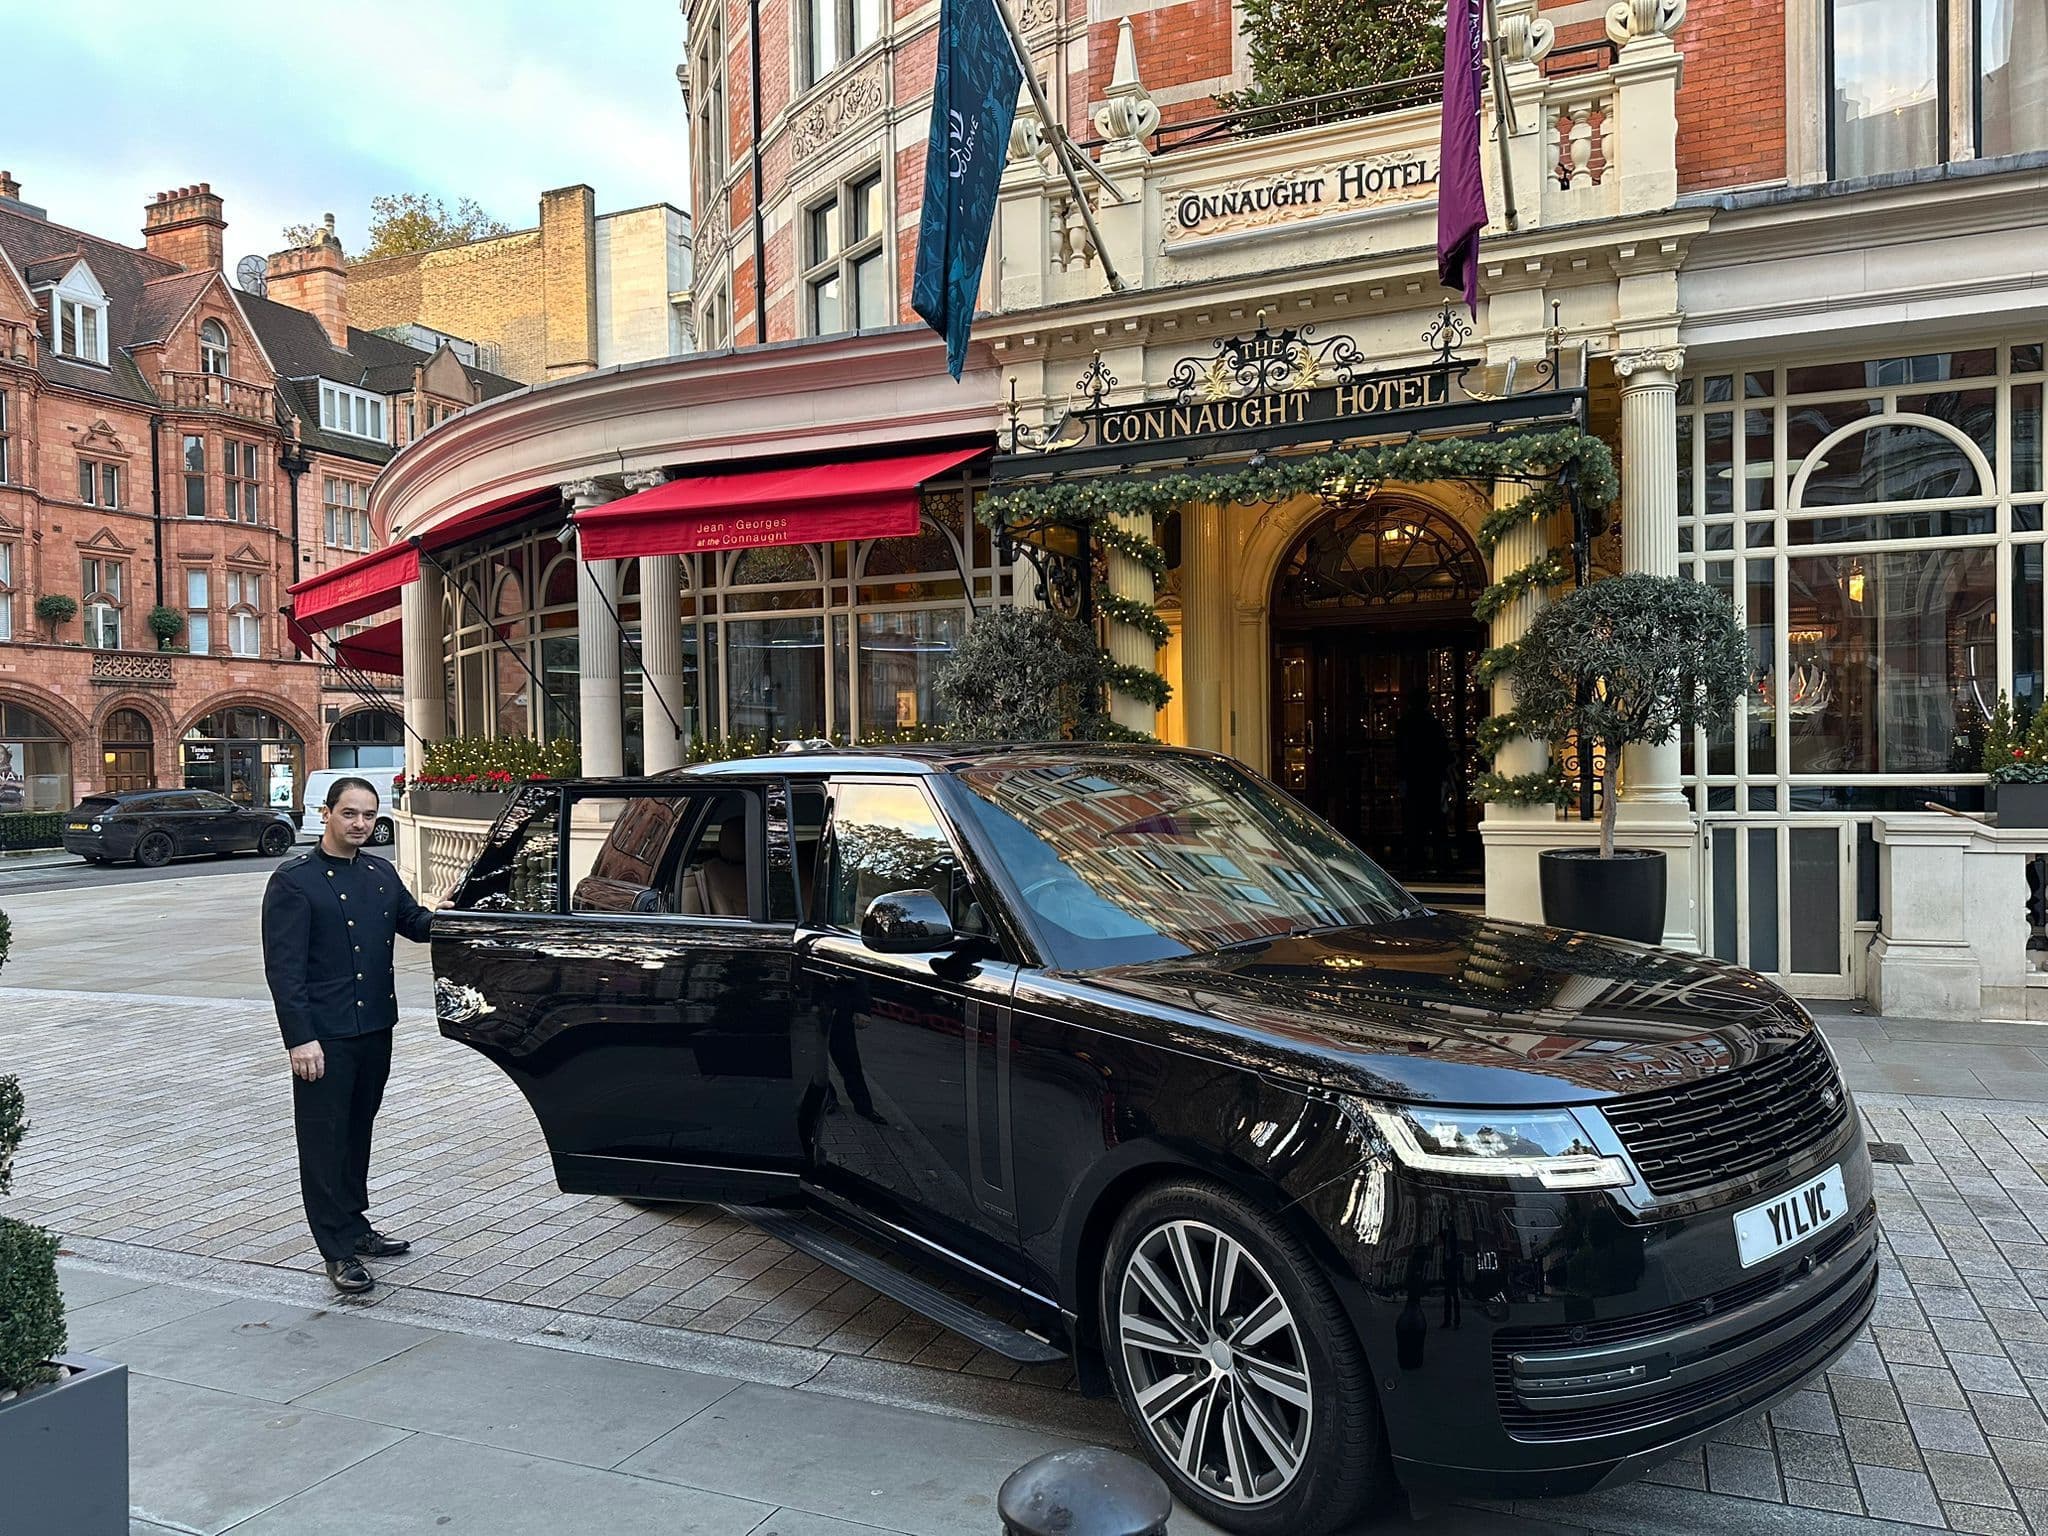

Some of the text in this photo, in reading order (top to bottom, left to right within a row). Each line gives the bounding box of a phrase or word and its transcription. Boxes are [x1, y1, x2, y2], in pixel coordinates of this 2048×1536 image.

[1178, 160, 1438, 228] CONNAUGHT HOTEL
[1240, 337, 1284, 360] THE
[1102, 375, 1445, 444] CONNAUGHT HOTEL
[696, 523, 724, 534] Jean
[735, 518, 787, 530] Georges
[696, 531, 787, 547] at the Connaught
